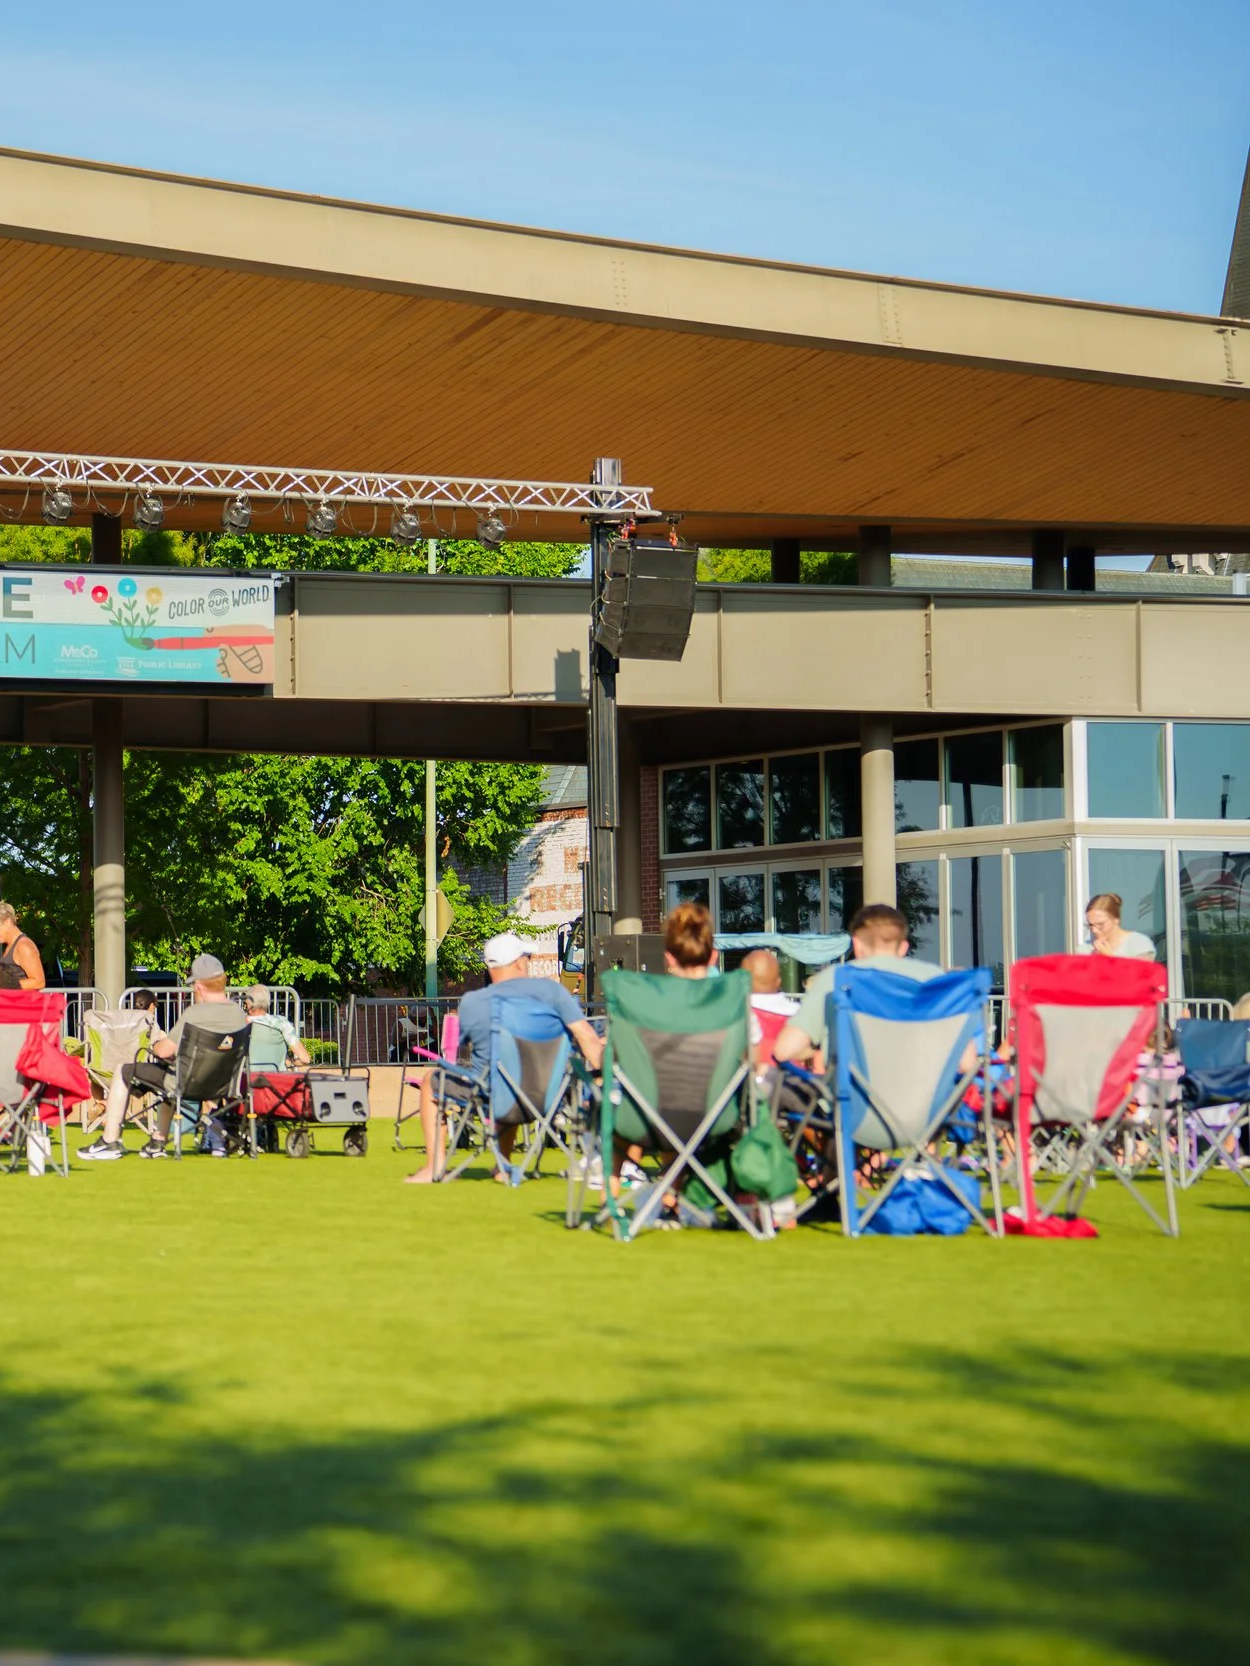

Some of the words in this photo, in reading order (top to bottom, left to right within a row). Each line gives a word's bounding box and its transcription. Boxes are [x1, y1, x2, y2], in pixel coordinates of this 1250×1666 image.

[168, 598, 205, 619] COLOR
[208, 597, 229, 608] OUR
[232, 585, 270, 608] WORLD
